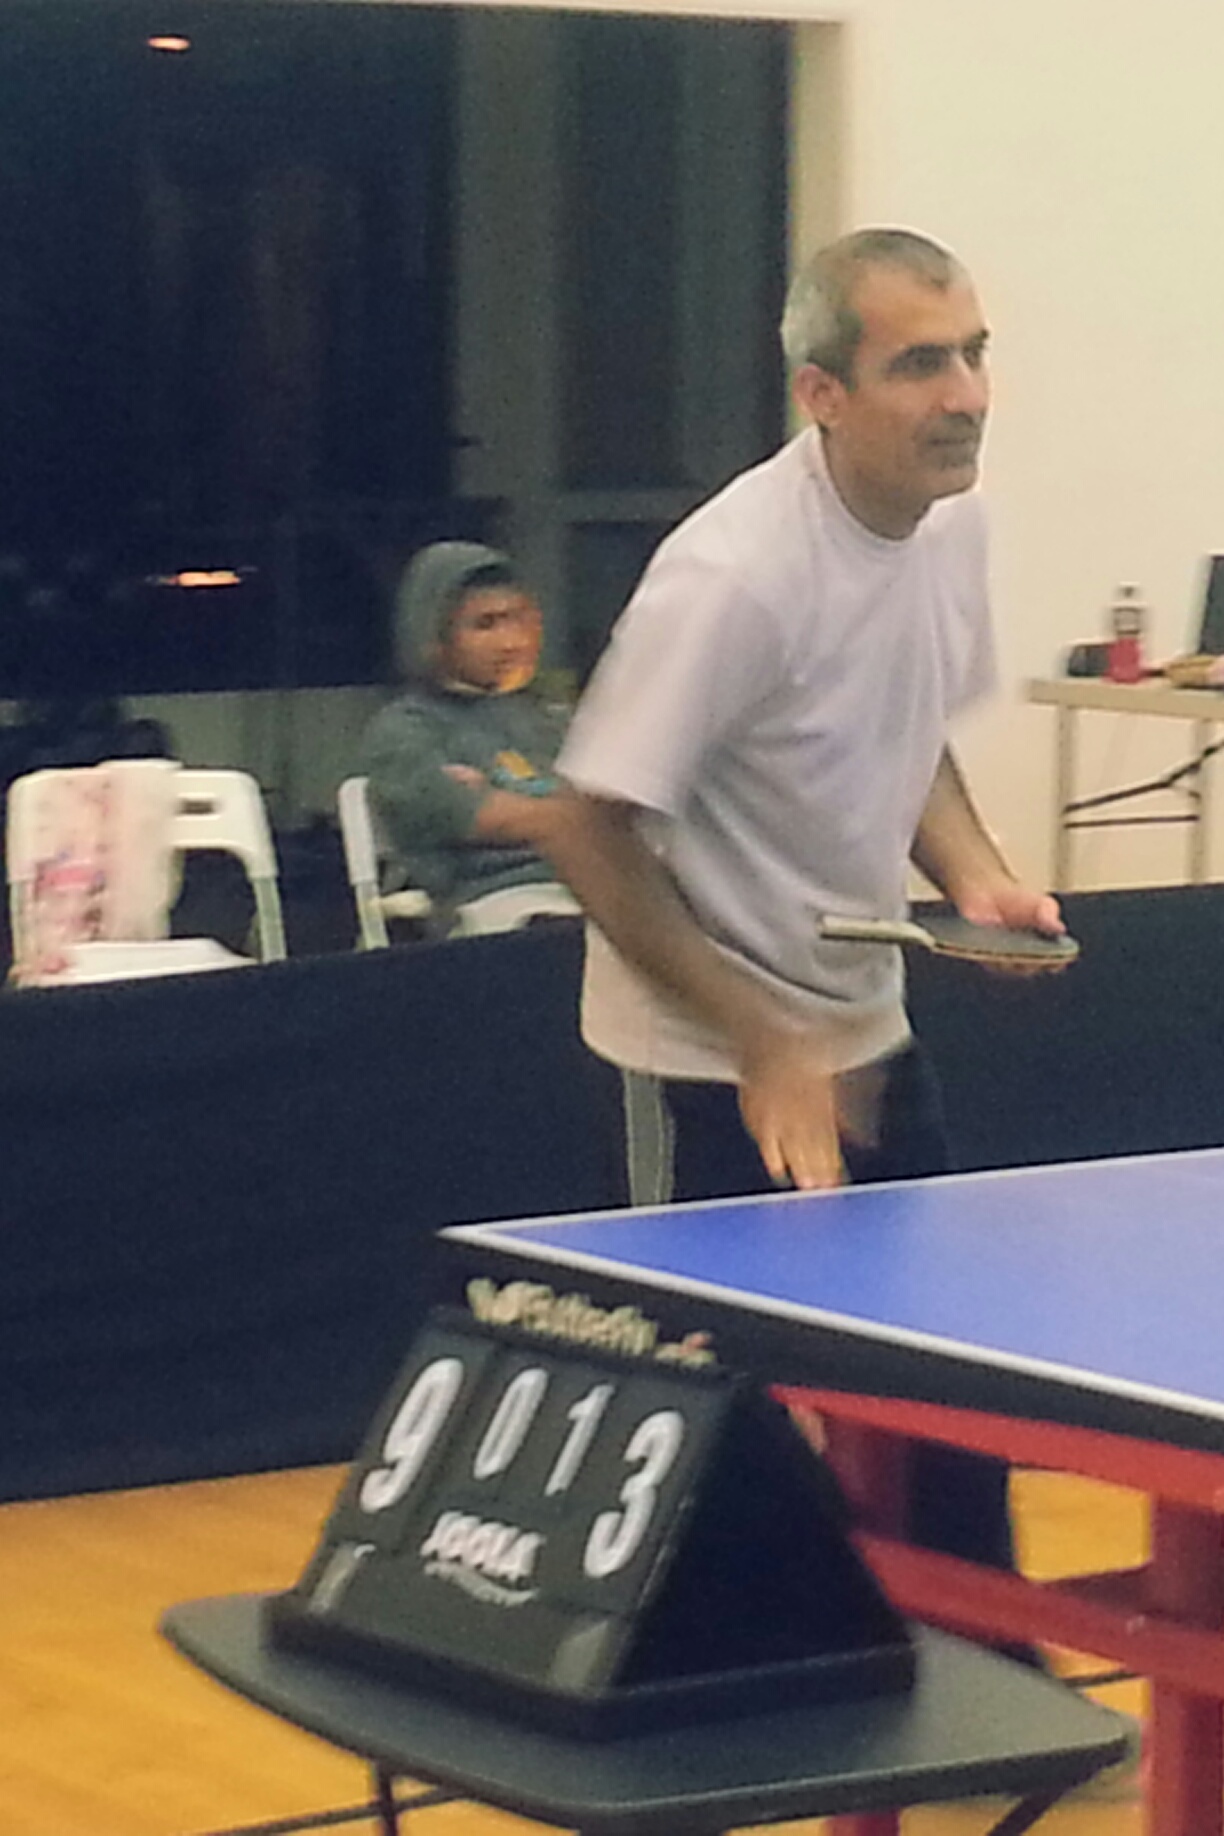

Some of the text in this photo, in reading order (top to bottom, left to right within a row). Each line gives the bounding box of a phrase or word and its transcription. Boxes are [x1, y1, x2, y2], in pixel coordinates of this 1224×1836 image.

[360, 1358, 686, 1578] 9 0 1 3
